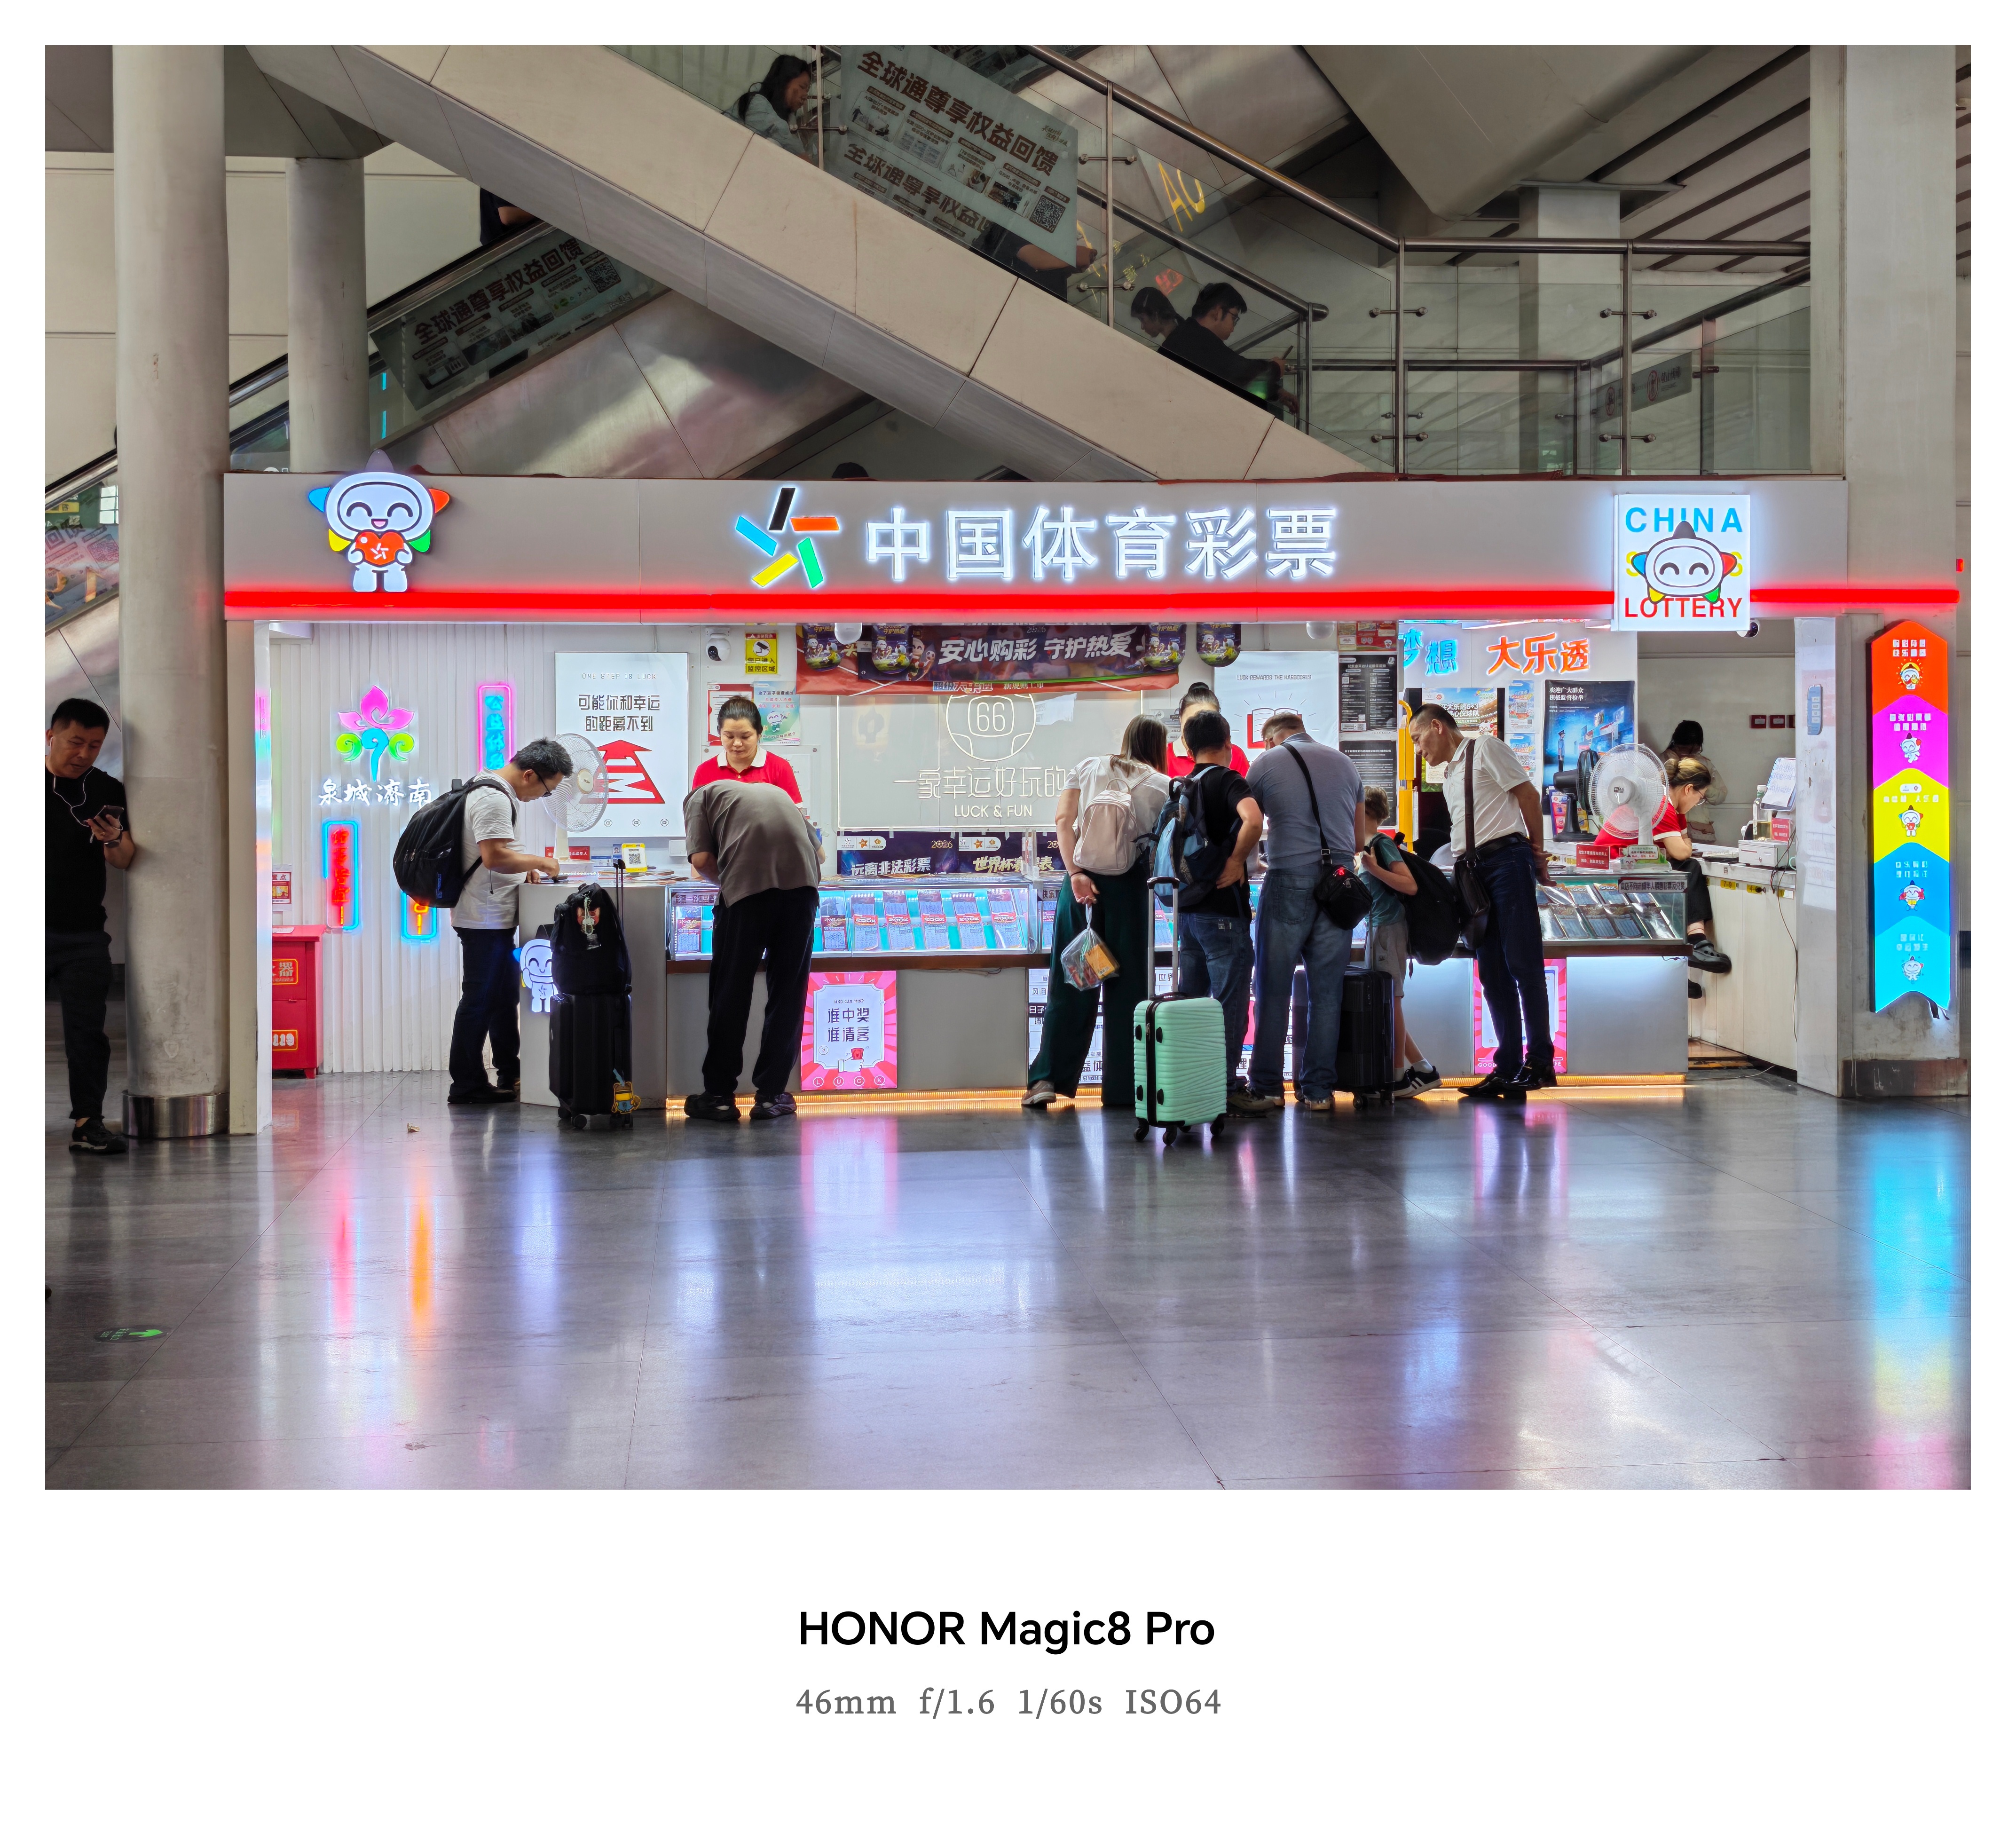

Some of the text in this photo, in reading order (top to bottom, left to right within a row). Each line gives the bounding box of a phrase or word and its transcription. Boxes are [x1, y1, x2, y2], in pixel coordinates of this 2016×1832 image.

[858, 51, 1059, 177] 全球通尊享权益回馈
[414, 237, 585, 346] 全球通尊享权益回馈
[1625, 507, 1743, 532] CHINA
[866, 506, 1337, 580] 中国体育彩票
[1624, 597, 1743, 618] LOTTERY
[938, 626, 1138, 664] 安心购彩 守护热爱
[1487, 632, 1591, 676] 大乐透
[578, 694, 661, 711] 可能你和幸运
[585, 715, 653, 732] 的距离不到
[976, 702, 1006, 732] 66
[893, 766, 1066, 800] 一家幸运好玩的
[954, 804, 1032, 819] LUCK & FUN
[851, 856, 931, 877] 远离非法彩票
[827, 1007, 869, 1023] 谁中奖
[827, 1026, 869, 1042] 谁请客
